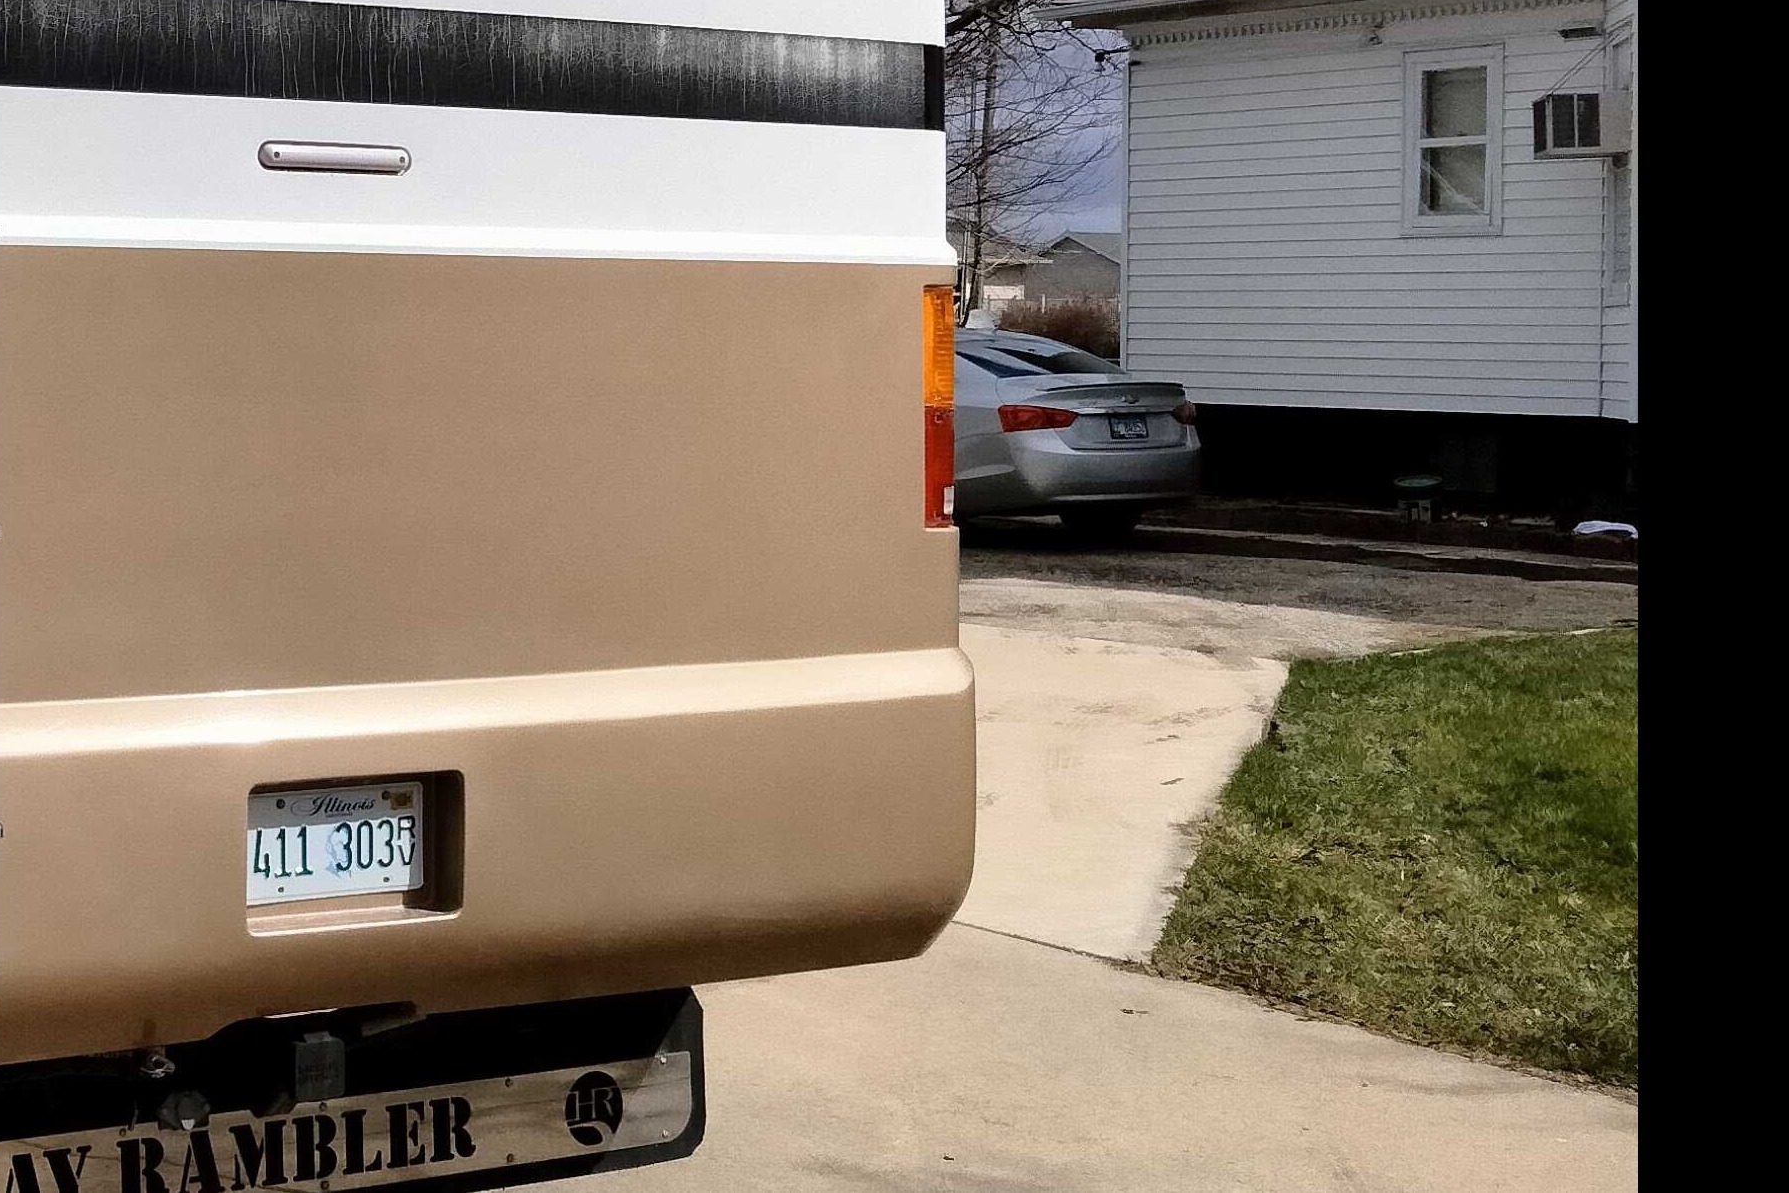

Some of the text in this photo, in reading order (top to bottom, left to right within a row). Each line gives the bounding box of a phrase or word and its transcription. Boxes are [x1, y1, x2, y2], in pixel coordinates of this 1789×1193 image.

[306, 793, 375, 817] Illinois
[253, 819, 394, 880] 411 303
[116, 1096, 477, 1193] RAMBLER
